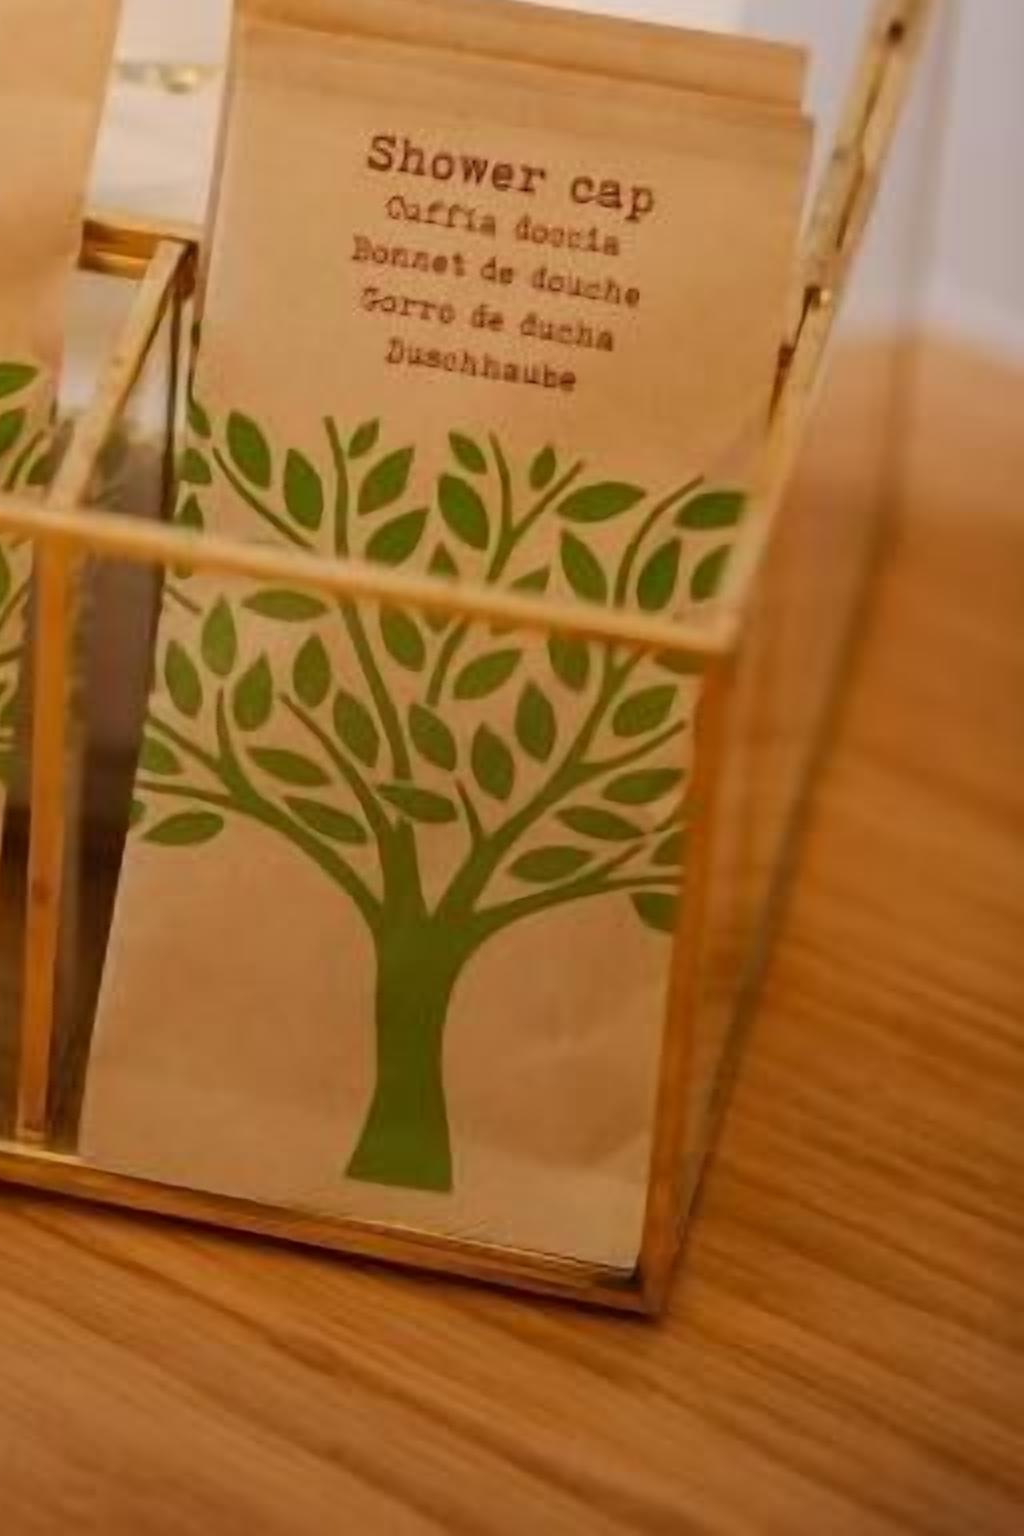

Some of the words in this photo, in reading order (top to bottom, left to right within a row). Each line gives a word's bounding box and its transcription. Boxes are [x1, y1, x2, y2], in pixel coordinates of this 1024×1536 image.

[367, 135, 546, 194] Shower
[570, 174, 655, 223] cap
[384, 194, 497, 237] Cuffia
[514, 214, 621, 256] doccia
[351, 235, 466, 277] Bonnet
[480, 256, 514, 285] de
[531, 265, 641, 308] douche
[360, 286, 456, 324] Gorro
[470, 303, 505, 331] de
[519, 313, 615, 352] ducha
[384, 336, 577, 392] Duschhaube
